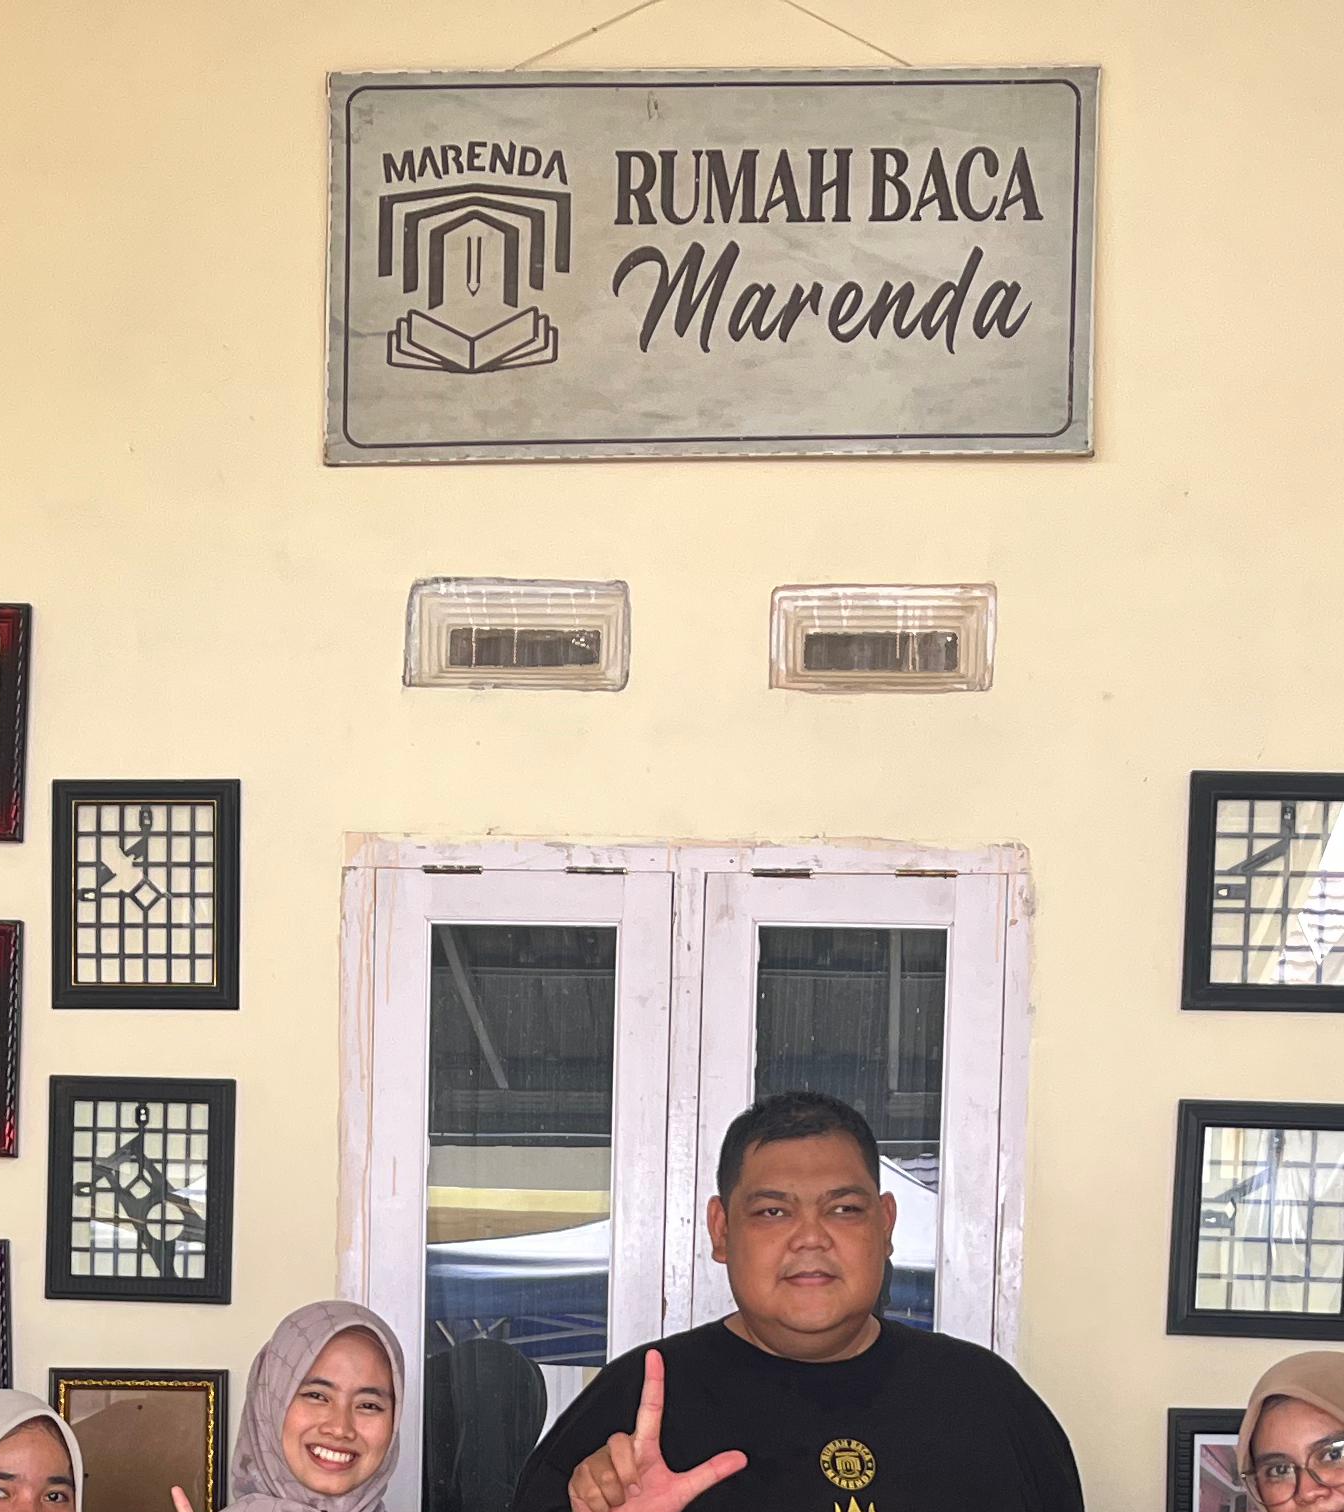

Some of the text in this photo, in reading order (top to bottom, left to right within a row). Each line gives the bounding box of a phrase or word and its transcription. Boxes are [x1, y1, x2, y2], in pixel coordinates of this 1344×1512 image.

[383, 141, 567, 185] MARENDA
[614, 147, 1043, 225] RUMAH BACA
[613, 241, 1032, 354] Marenda
